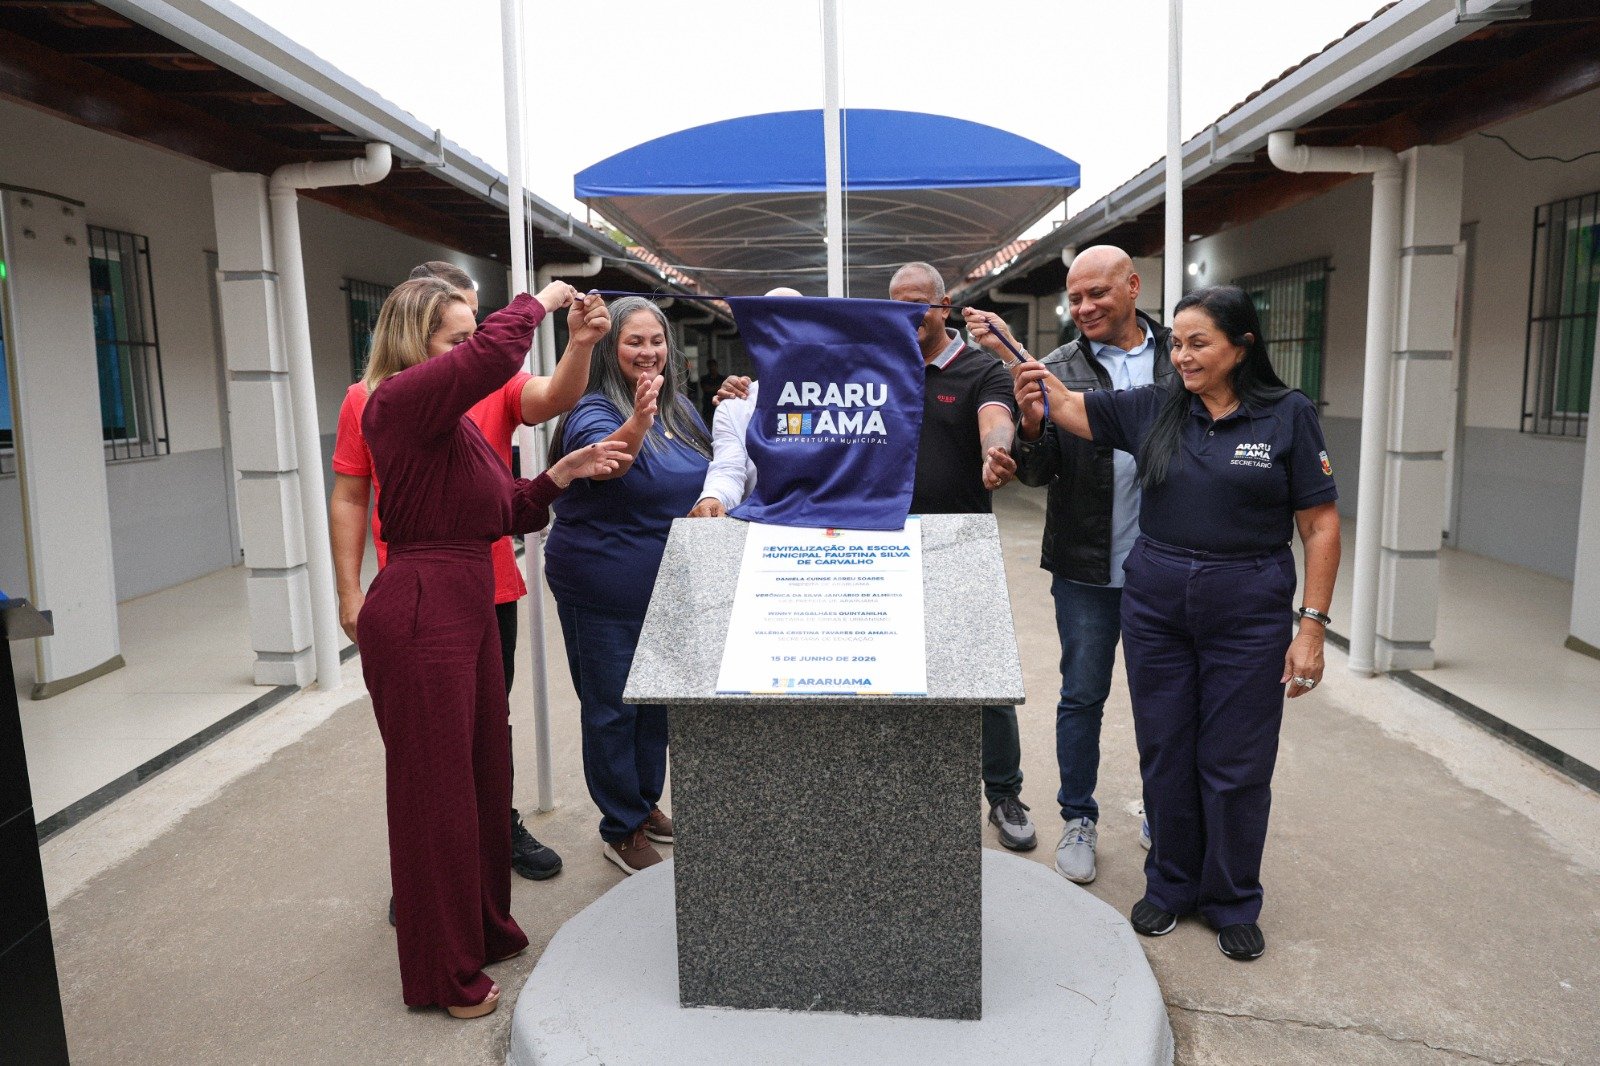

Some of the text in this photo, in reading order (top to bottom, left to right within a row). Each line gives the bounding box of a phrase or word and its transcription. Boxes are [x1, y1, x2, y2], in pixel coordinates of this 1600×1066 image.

[776, 381, 888, 408] ARARU
[813, 409, 888, 436] AMA
[840, 437, 887, 445] MUNICIPAL
[1236, 443, 1272, 451] ARARU
[1246, 451, 1270, 459] AMA
[762, 544, 846, 552] REVITALIZAÇÃO
[797, 678, 872, 686] ARARUAMA
